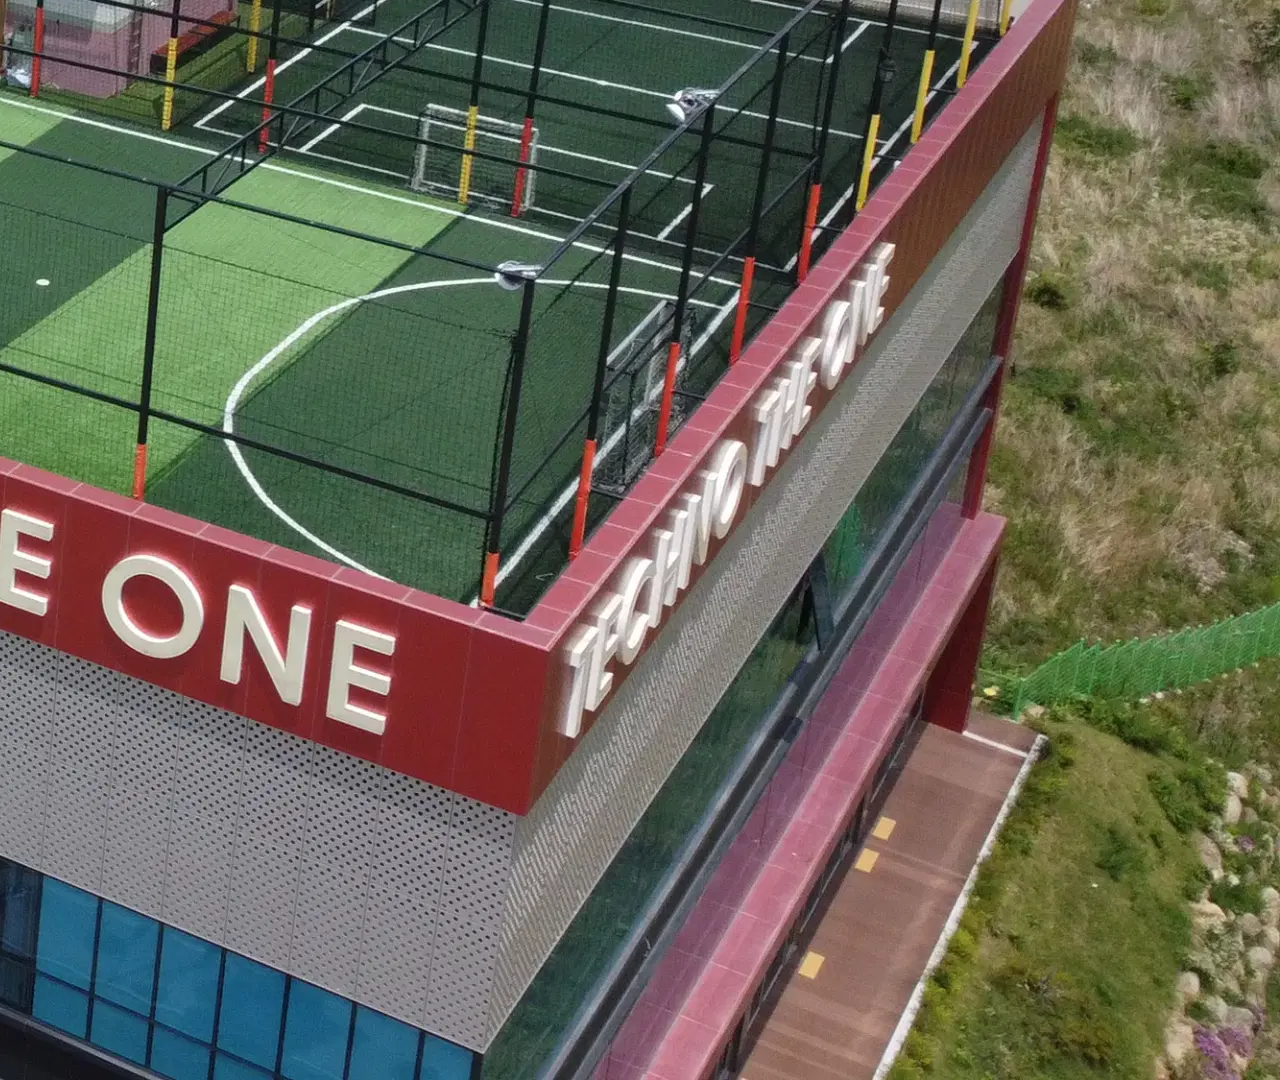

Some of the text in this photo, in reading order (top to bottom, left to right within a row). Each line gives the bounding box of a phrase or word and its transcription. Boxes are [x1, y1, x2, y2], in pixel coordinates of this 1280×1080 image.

[100, 553, 396, 736] ONE
[558, 241, 896, 739] TECHNO THE ONE
